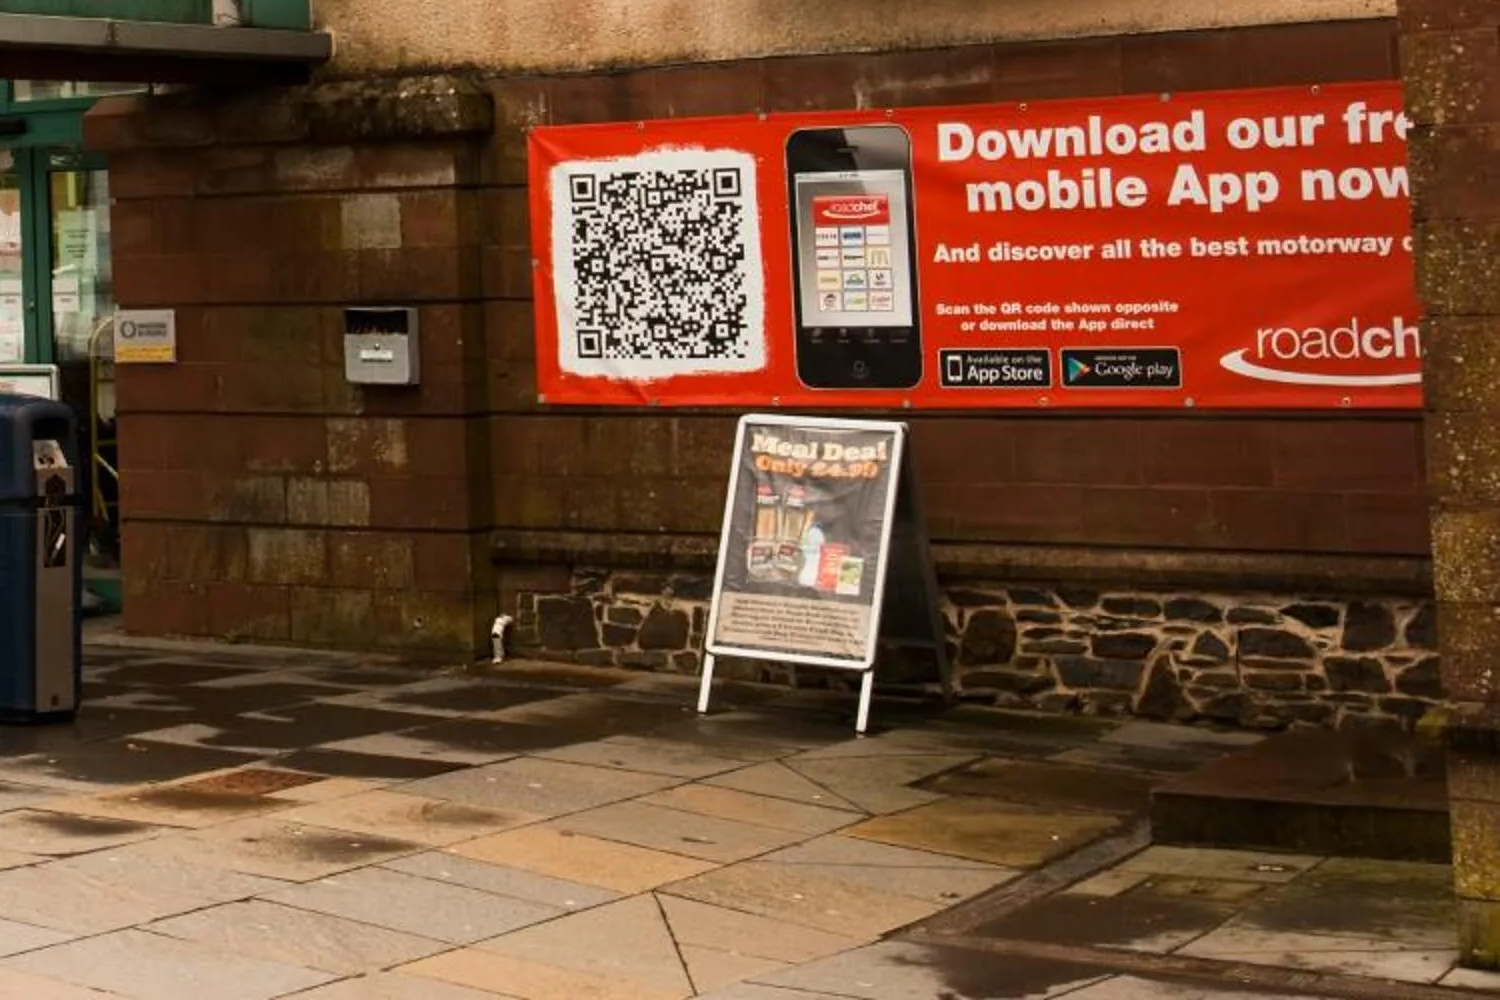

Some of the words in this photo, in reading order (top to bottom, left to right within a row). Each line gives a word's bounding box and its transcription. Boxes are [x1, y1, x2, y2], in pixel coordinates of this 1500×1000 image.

[937, 109, 1206, 162] Download
[1227, 114, 1325, 150] our
[966, 167, 1148, 212] mobile
[1167, 163, 1280, 214] App
[1300, 165, 1410, 201] now
[933, 243, 980, 263] And
[988, 241, 1095, 261] discover
[1101, 239, 1131, 259] all
[1140, 238, 1182, 259] the
[1190, 236, 1249, 258] best
[1257, 234, 1393, 257] motorway
[935, 303, 970, 316] Scan
[973, 302, 997, 315] the
[1000, 302, 1022, 315] QR
[1025, 301, 1061, 315] code
[1064, 301, 1112, 314] shown
[1115, 300, 1180, 316] opposite
[960, 320, 977, 331] or
[979, 318, 1048, 331] download
[1050, 317, 1075, 330] the
[1078, 317, 1108, 333] App
[1110, 316, 1156, 330] direct
[1256, 315, 1422, 361] roadch
[967, 365, 1001, 384] App
[1002, 364, 1044, 381] Store
[1094, 361, 1145, 381] Google
[1147, 361, 1175, 381] play
[751, 432, 819, 460] Meal
[822, 440, 887, 462] Deal
